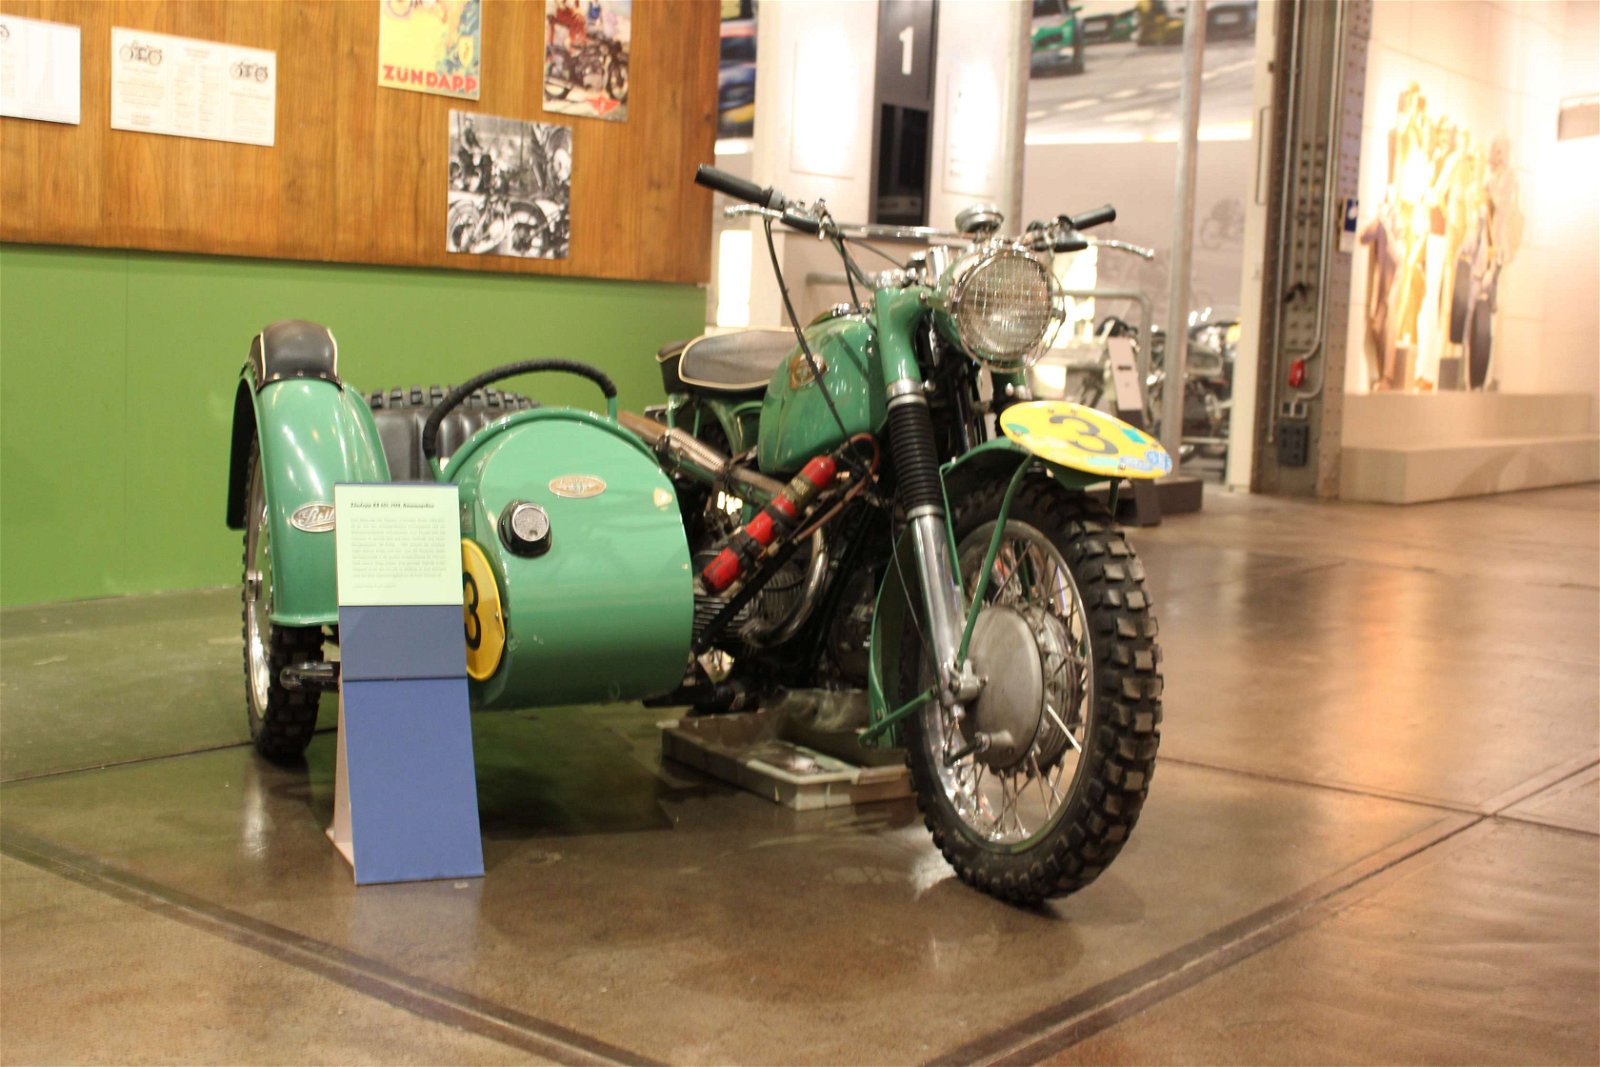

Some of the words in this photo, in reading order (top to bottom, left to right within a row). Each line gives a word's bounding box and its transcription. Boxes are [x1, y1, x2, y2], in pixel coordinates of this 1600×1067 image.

[899, 26, 914, 75] 1
[1048, 415, 1119, 455] 3
[463, 572, 482, 651] 3
